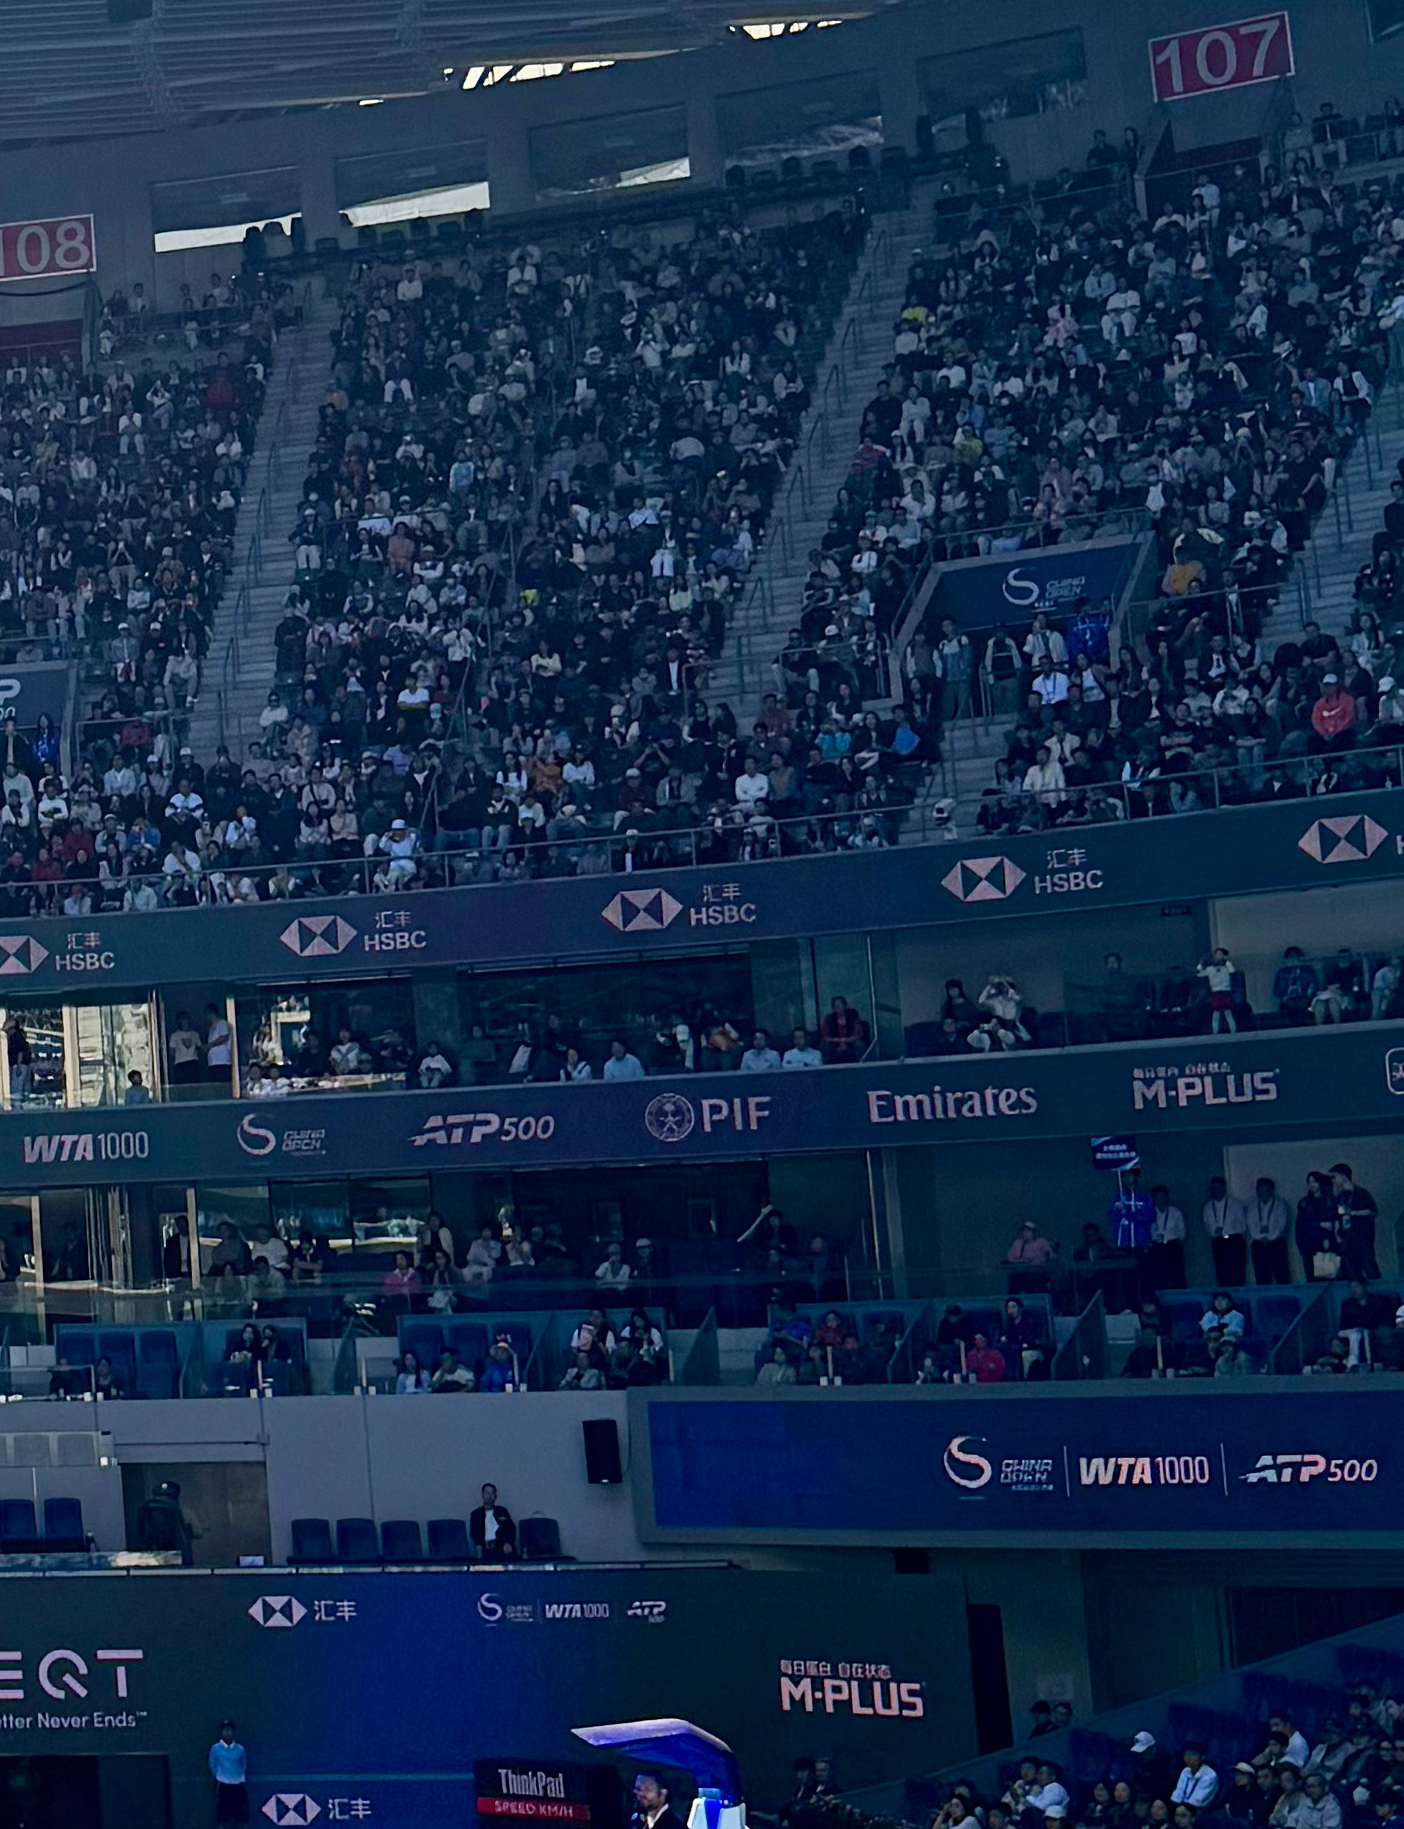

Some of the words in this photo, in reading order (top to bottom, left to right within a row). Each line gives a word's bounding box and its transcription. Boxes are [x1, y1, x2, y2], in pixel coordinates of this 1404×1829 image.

[1155, 19, 1281, 93] 107
[1046, 848, 1087, 868] 汇丰
[1033, 869, 1104, 894] HSBC
[703, 883, 743, 904] 汇丰
[376, 911, 411, 928] 汇丰
[690, 904, 757, 927] HSBC
[66, 932, 100, 949] 汇丰
[364, 930, 427, 951] HSBC
[54, 953, 115, 971] HSBC
[700, 1096, 771, 1133] PIF
[867, 1085, 1038, 1123] Emirates
[408, 1113, 500, 1146] ATP
[500, 1115, 555, 1142] 500
[23, 1134, 94, 1163] WTA
[98, 1132, 149, 1159] 1000
[1079, 1457, 1151, 1485] WTA
[1154, 1456, 1209, 1484] 1000
[1239, 1454, 1326, 1483] ATP
[1328, 1458, 1378, 1482] 500
[314, 1600, 357, 1621] 汇丰
[545, 1604, 581, 1619] WTA
[583, 1603, 610, 1618] 1000
[626, 1601, 667, 1616] ATP
[37, 1712, 89, 1728] Never
[497, 1768, 566, 1799] ThinkPad
[328, 1798, 371, 1820] 汇丰
[494, 1799, 536, 1816] SPEED
[538, 1801, 574, 1818] KM/H
